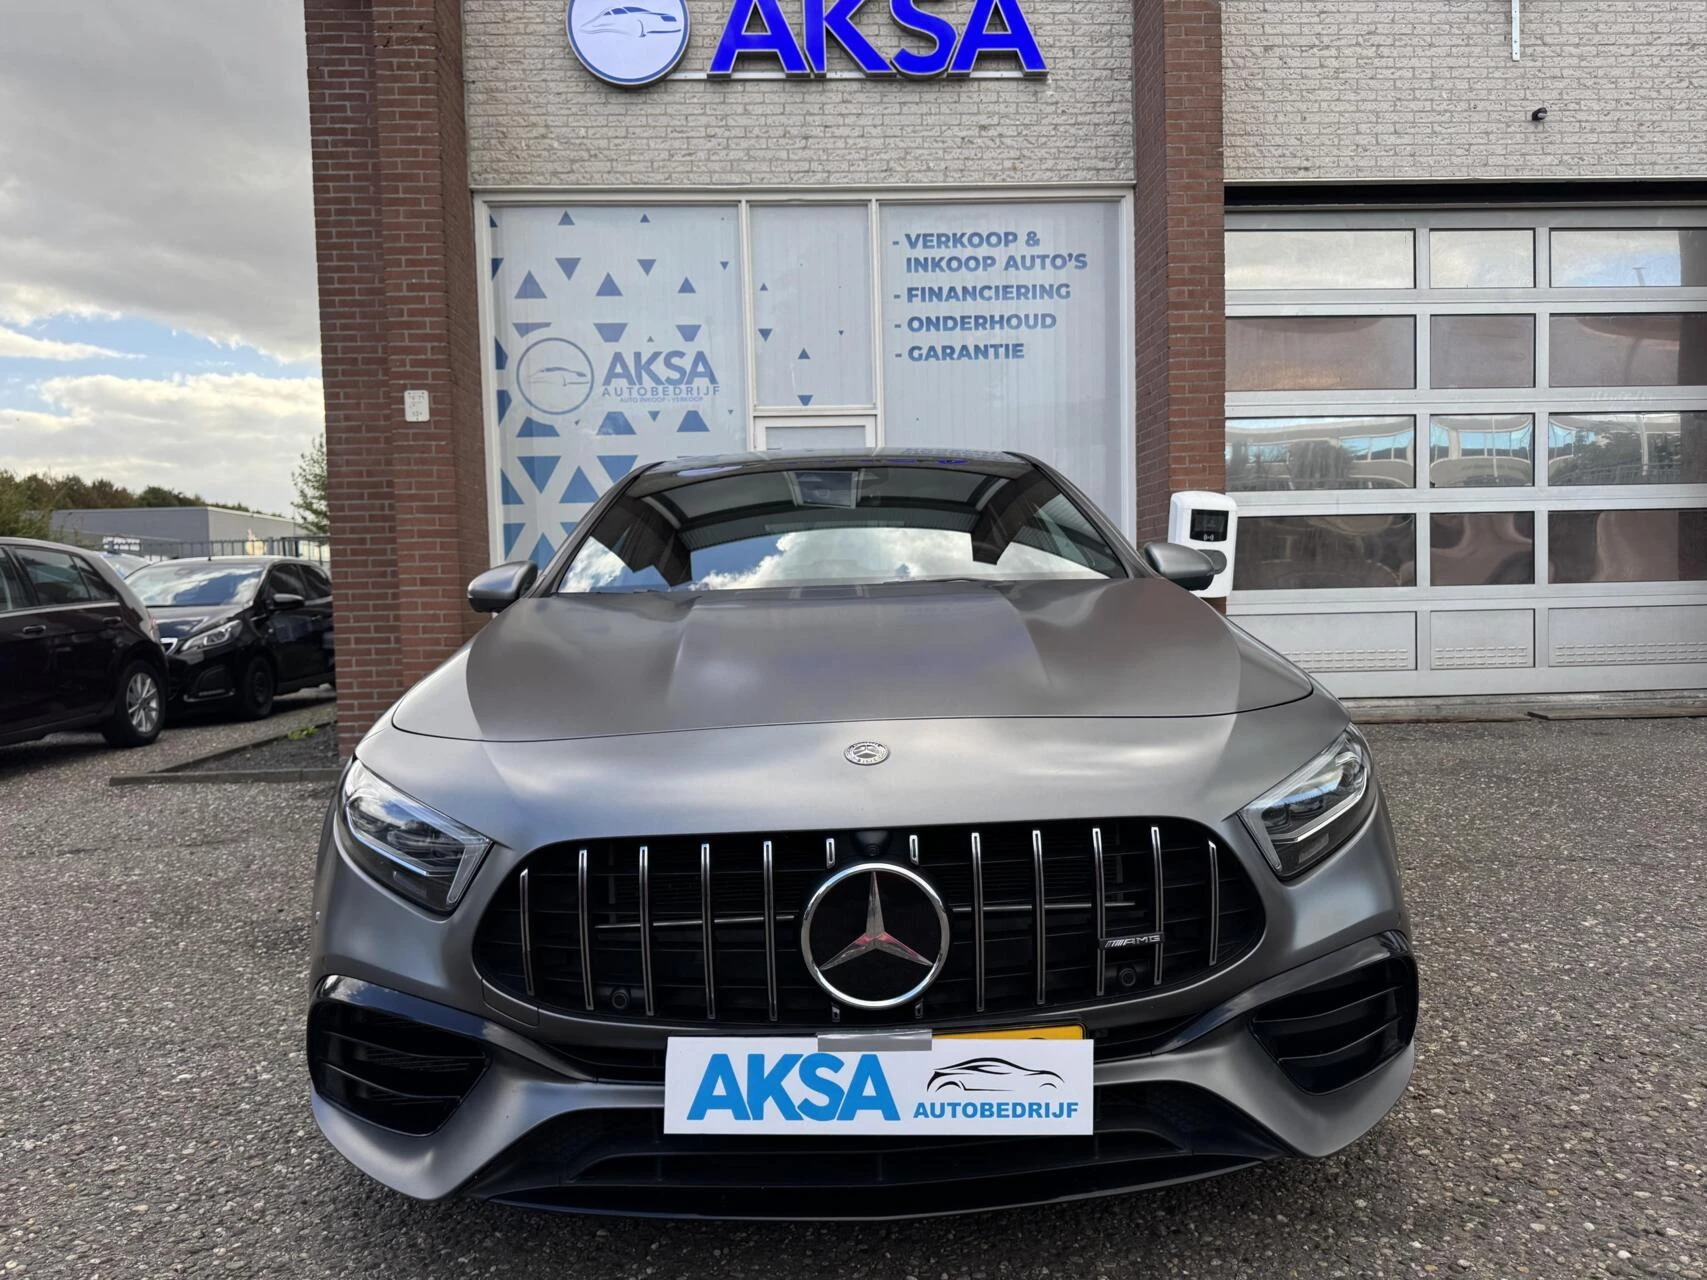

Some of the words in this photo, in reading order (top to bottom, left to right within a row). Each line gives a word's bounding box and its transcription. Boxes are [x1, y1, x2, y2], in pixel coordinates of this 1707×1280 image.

[707, 0, 1050, 79] AKSA
[904, 231, 1018, 249] VERKOOP
[1024, 230, 1040, 247] &
[905, 255, 997, 273] INKOOP
[906, 283, 1071, 303] FINANCIERING
[907, 313, 1057, 332] ONDERHOUD
[907, 343, 1025, 362] GARANTIE
[602, 350, 719, 386] AKSA
[602, 385, 720, 397] AUTOBEDRIJF
[686, 1052, 901, 1122] AKSA
[912, 1101, 1079, 1119] AUTOBEDRIJF
